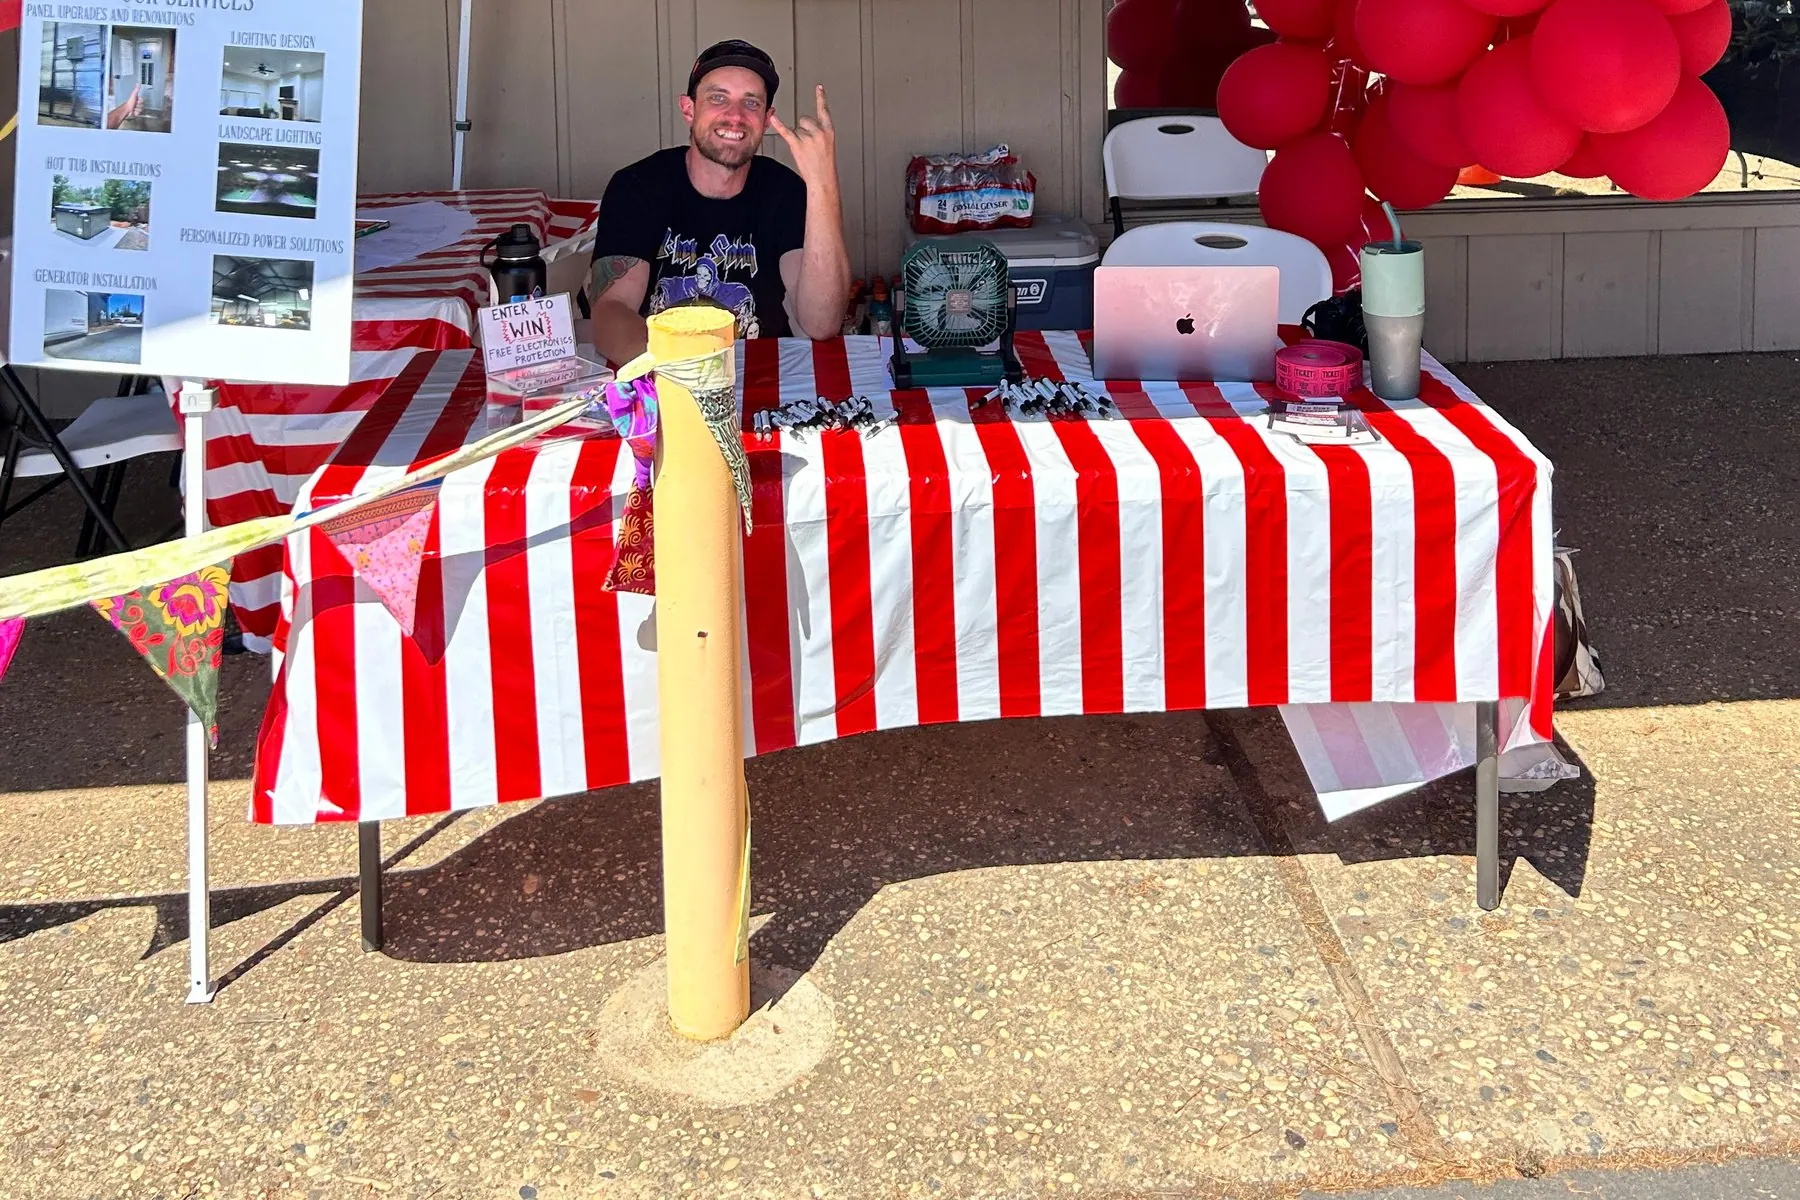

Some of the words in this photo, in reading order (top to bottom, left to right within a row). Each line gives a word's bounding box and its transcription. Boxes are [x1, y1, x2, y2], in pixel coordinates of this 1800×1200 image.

[26, 3, 55, 18] PANEL
[58, 5, 108, 21] UPGRADES
[110, 8, 130, 23] AND
[132, 9, 195, 27] RENOVATIONS
[230, 30, 277, 47] LIGHTING
[280, 33, 316, 49] DESIGN
[218, 123, 273, 142] LANDSCAPE
[276, 128, 322, 145] LIGHTING
[46, 156, 66, 171] HOT
[68, 157, 88, 173] TUB
[90, 159, 162, 178] INSTALLATIONS
[937, 199, 947, 208] 24
[180, 227, 250, 247] PERSONALIZED
[253, 233, 287, 250] POWER
[290, 236, 344, 254] SOLUTIONS
[35, 268, 89, 286] GENERATOR
[91, 272, 158, 290] INSTALLATION
[491, 302, 529, 321] ENTER
[535, 299, 554, 310] TO
[508, 317, 545, 338] WIN
[488, 346, 513, 361] FREE
[516, 335, 573, 354] ELECTRONICS
[515, 346, 566, 365] PROTECTION
[1295, 368, 1314, 378] TICKET
[1322, 370, 1341, 378] TICKET
